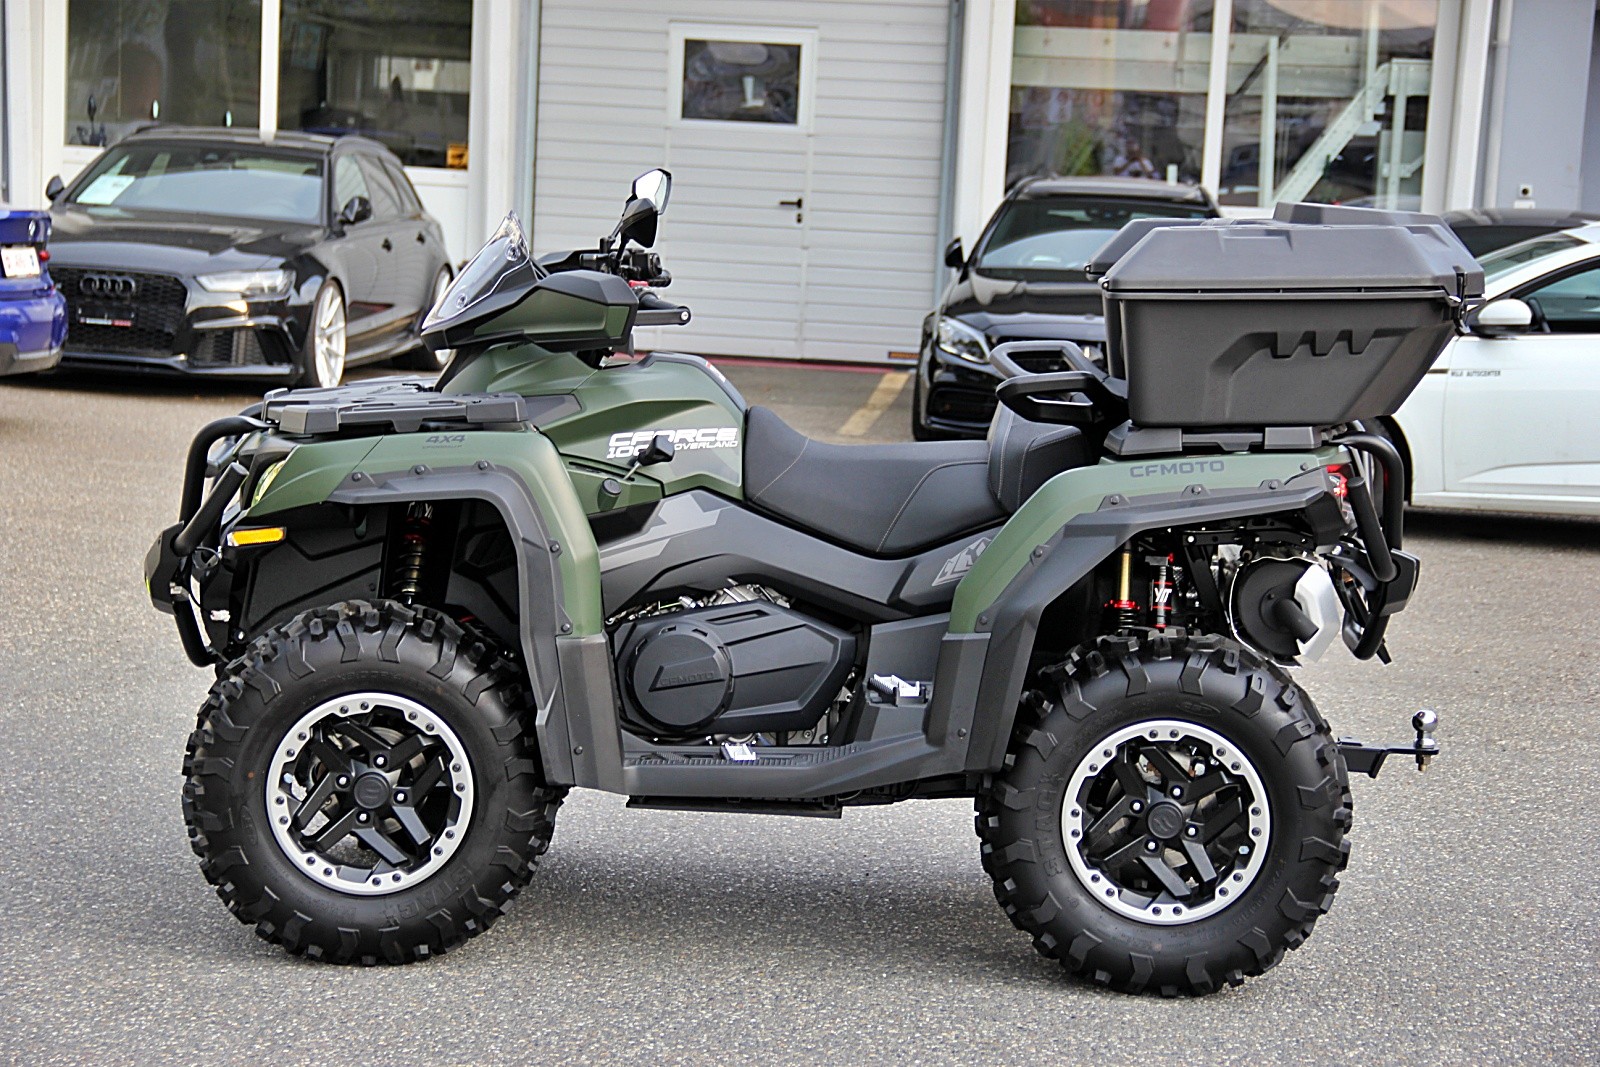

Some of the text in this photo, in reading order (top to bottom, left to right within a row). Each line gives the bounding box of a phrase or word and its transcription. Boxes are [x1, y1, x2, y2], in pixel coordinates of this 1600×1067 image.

[674, 441, 738, 451] OVERLAND
[1130, 460, 1225, 478] CFMOTO
[660, 672, 714, 687] CFMOTO
